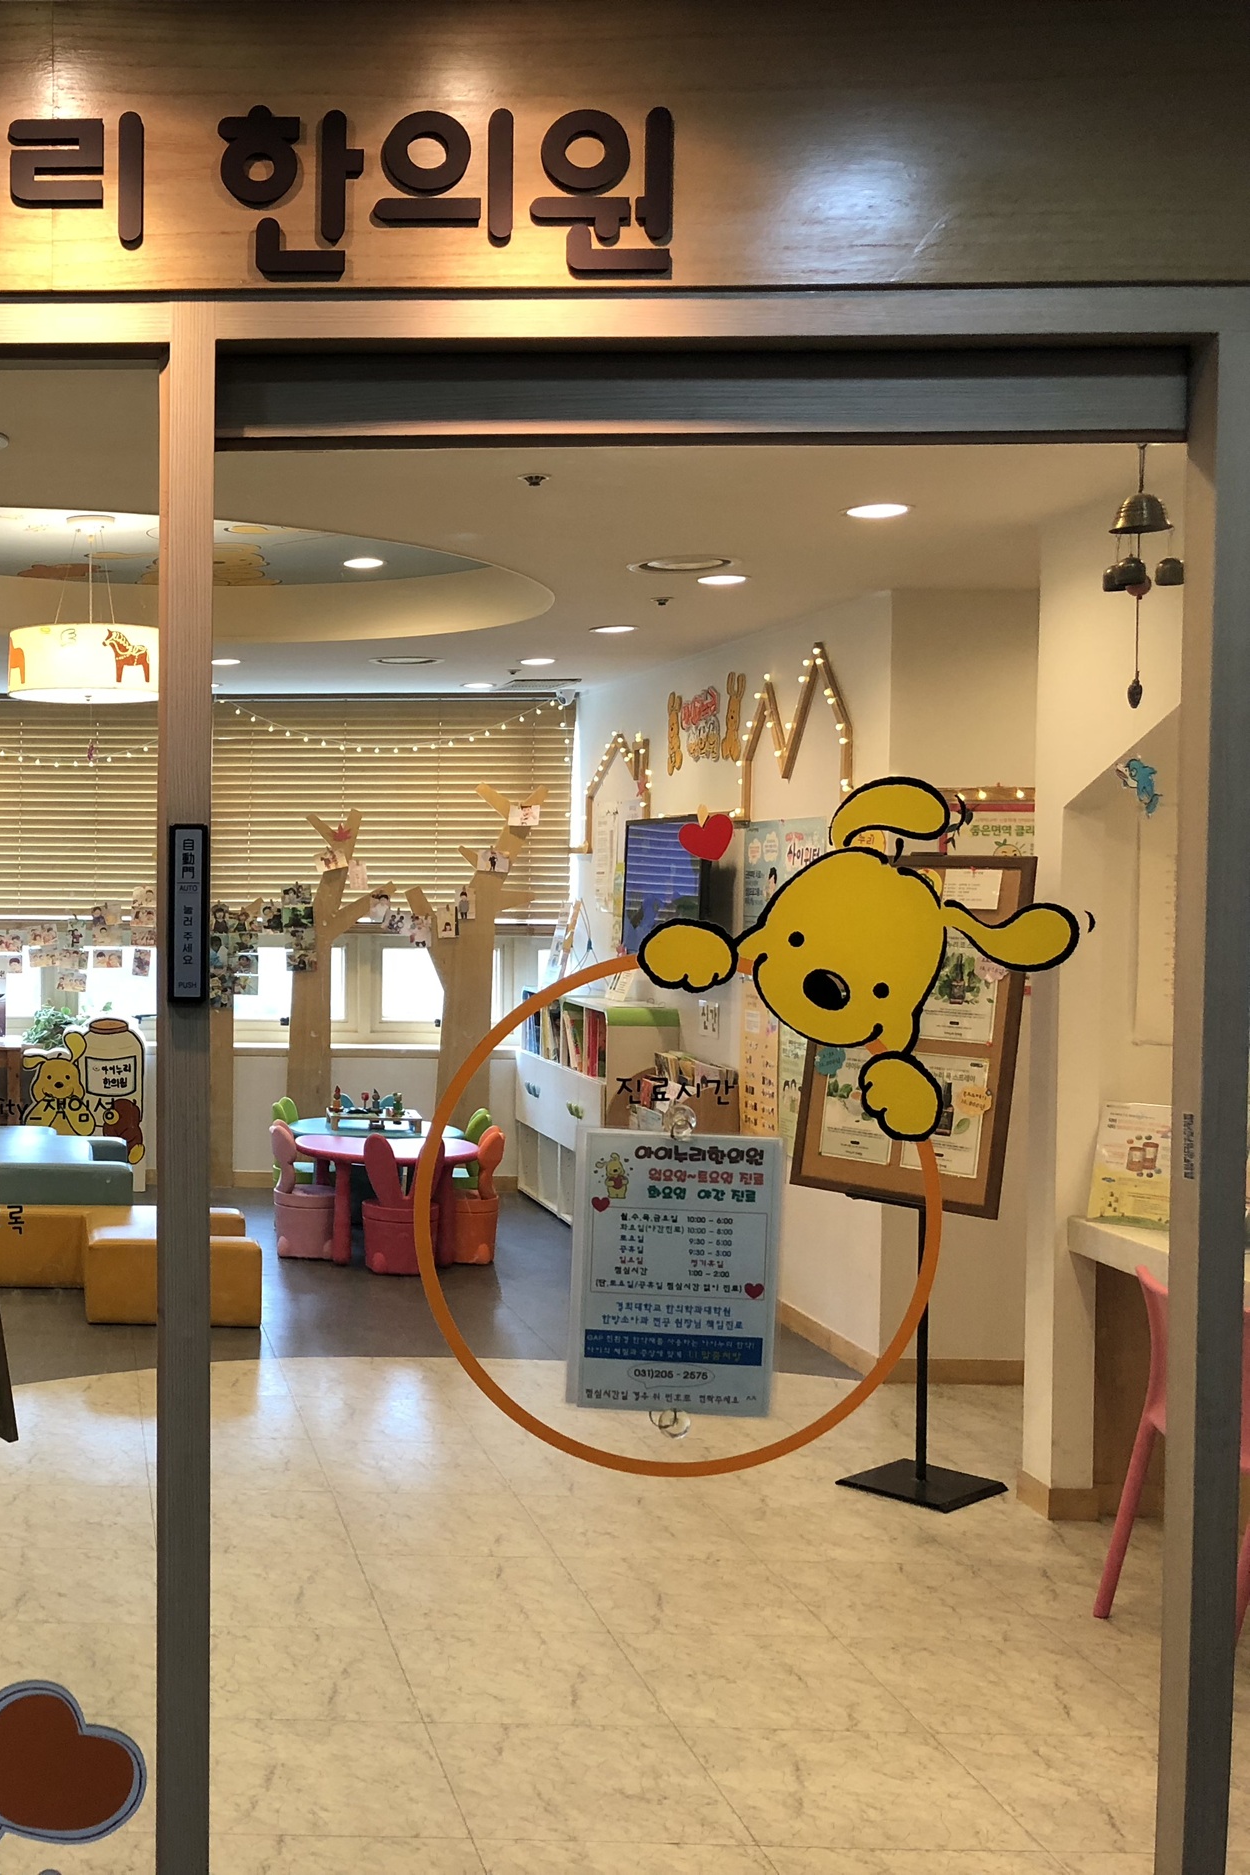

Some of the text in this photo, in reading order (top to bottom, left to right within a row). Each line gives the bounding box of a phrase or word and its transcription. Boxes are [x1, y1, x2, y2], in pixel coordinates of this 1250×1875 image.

[217, 104, 673, 279] 한의원
[181, 838, 196, 879] 自動門
[179, 884, 198, 893] AUTO
[182, 931, 194, 965] 주세요
[178, 981, 197, 990] PUSH
[101, 1064, 132, 1075] 아이누리
[102, 1077, 128, 1089] 한의원
[615, 1076, 737, 1107] 진료시간
[634, 1145, 765, 1166] 아이누리한의원
[739, 1171, 764, 1186] 진료
[647, 1185, 757, 1203] 화요일 야간 진료
[686, 1215, 707, 1225] 10:00
[716, 1217, 734, 1225] 6:00
[686, 1226, 707, 1236] 10:00
[619, 1234, 645, 1244] 토요일
[688, 1237, 706, 1246] 9:30
[618, 1245, 645, 1255] 공휴일
[619, 1256, 725, 1269] 일요일 정기휴일
[614, 1266, 648, 1276] 점심시간
[687, 1269, 703, 1278] 1:00
[713, 1270, 730, 1279] 2:00
[633, 1368, 674, 1379] 031)205
[682, 1371, 709, 1381] 2575
